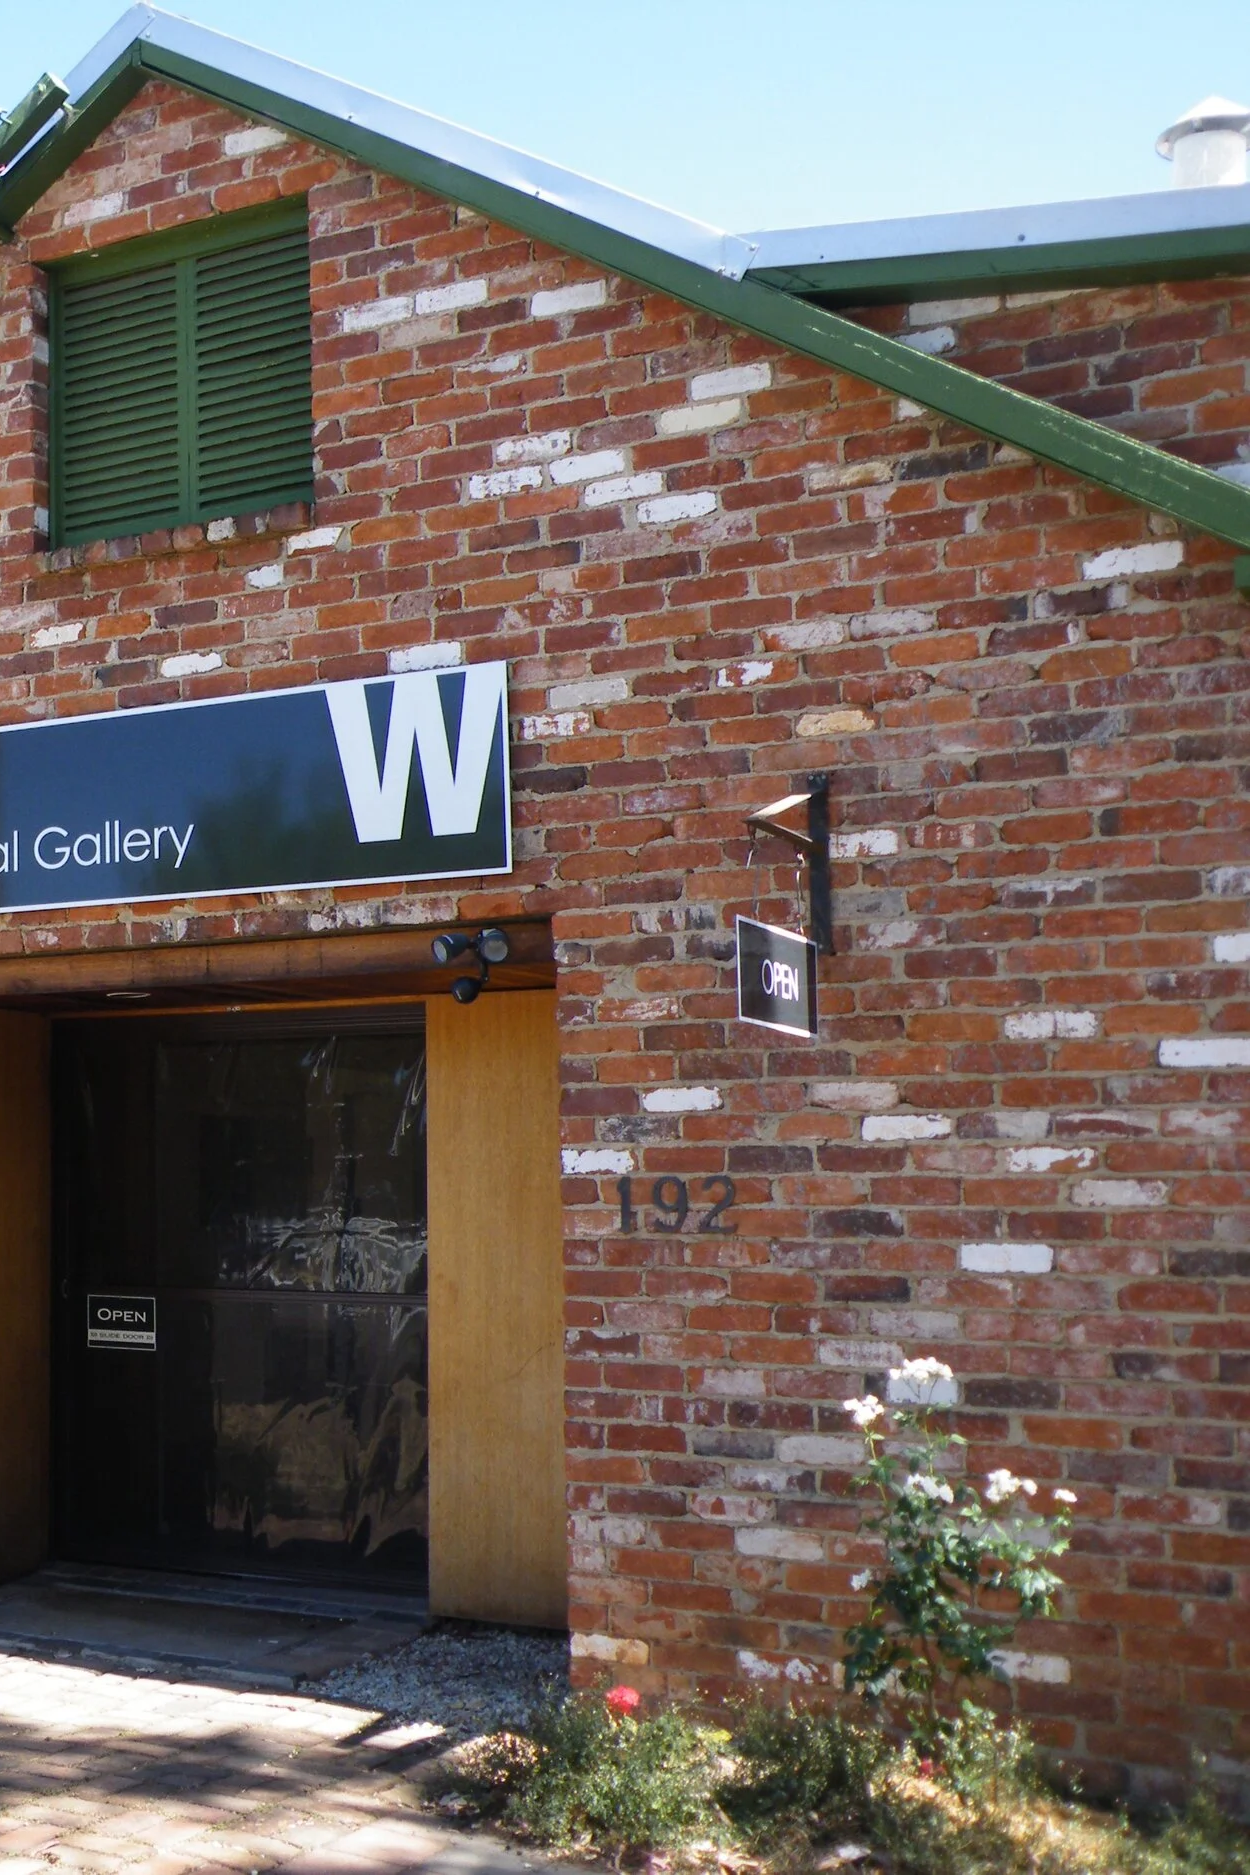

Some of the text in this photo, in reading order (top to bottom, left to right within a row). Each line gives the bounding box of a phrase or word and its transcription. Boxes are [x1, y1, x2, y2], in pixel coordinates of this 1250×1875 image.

[325, 664, 504, 844] W
[33, 820, 195, 869] Gallery
[761, 958, 800, 1002] OPEN
[617, 1175, 738, 1234] 192
[97, 1307, 147, 1323] OPEN
